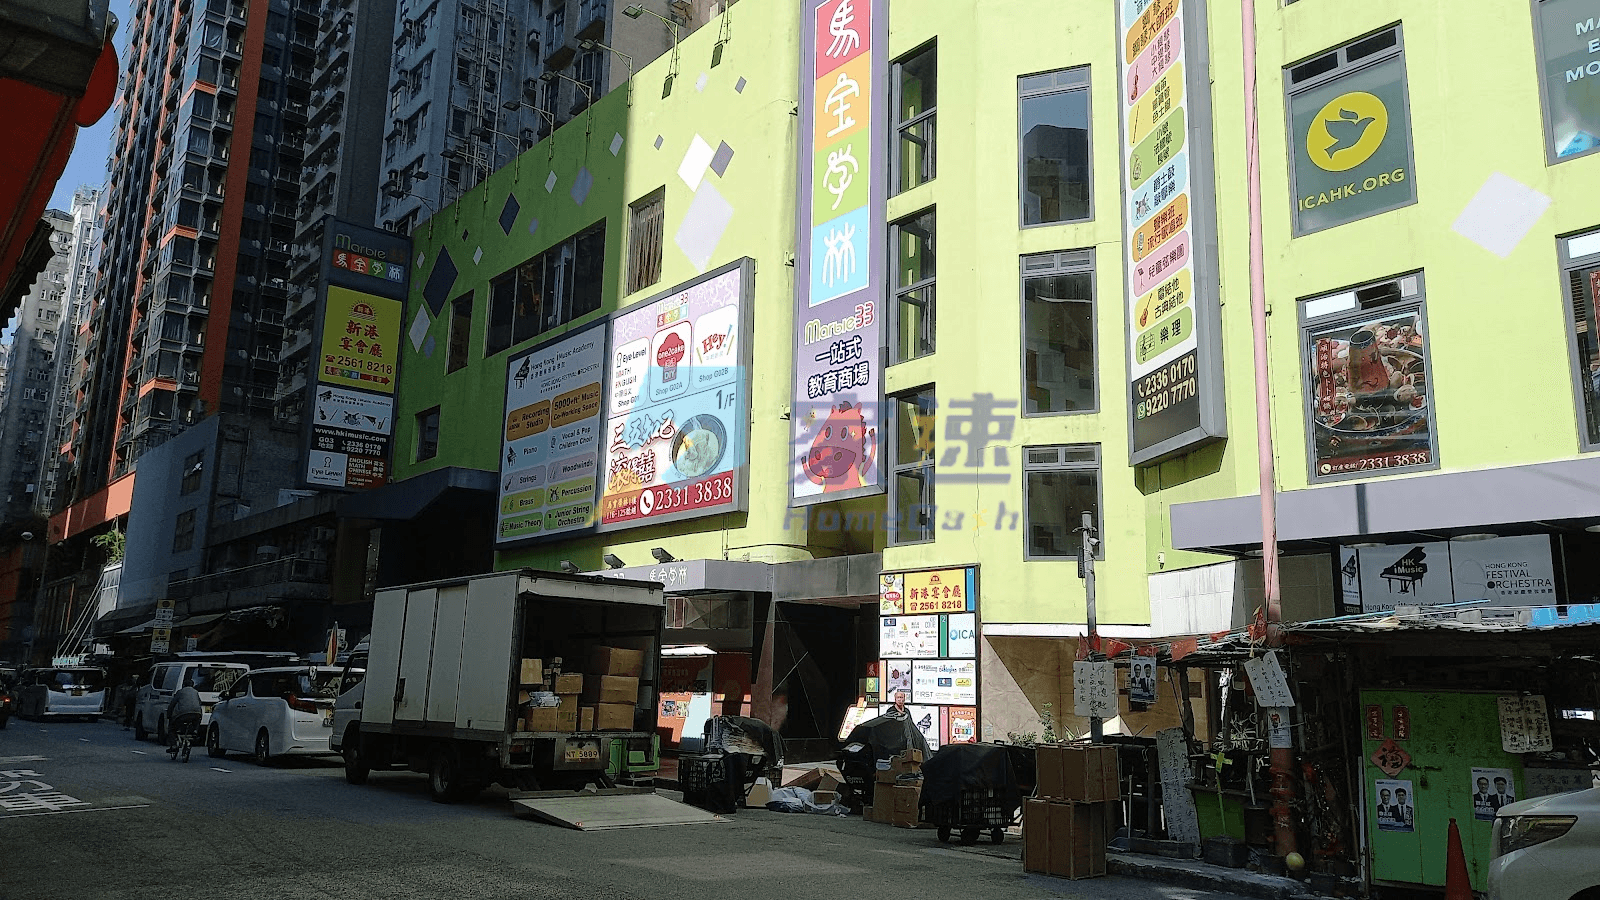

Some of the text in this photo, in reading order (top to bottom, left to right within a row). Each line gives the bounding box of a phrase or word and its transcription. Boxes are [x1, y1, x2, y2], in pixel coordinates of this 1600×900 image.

[1299, 168, 1405, 211] ICAHK.ORG
[1147, 213, 1183, 251] 流行歌唱班
[1157, 277, 1180, 301] 電結他
[1154, 290, 1184, 319] 古典結他
[345, 319, 379, 340] 新港
[804, 301, 875, 346] Marble33
[338, 336, 383, 358] 宴會廳
[658, 344, 685, 360] one2cake
[815, 334, 862, 366] 一站式
[622, 347, 647, 364] Eye Level
[337, 355, 392, 375] 2561 8218
[664, 369, 676, 380] DIY
[698, 372, 713, 382] Shop
[807, 360, 870, 399] 教育商場
[1145, 354, 1195, 396] 2336 0170
[581, 390, 599, 401] Music
[655, 386, 668, 396] Shop
[1145, 377, 1196, 417] 9220 7770
[582, 400, 598, 411] Space
[617, 397, 629, 408] Shop
[715, 389, 736, 411] 1/F
[521, 406, 550, 422] Recording
[526, 418, 544, 430] Studio
[314, 427, 387, 443] www.hkimusic.com
[318, 436, 334, 444] G03
[561, 429, 575, 440] Vocal
[581, 425, 591, 435] Pop
[558, 435, 594, 451] Children Choir
[364, 448, 381, 456] 7770
[523, 446, 538, 456] Piano
[562, 458, 594, 474] Woodwinds
[1359, 456, 1390, 470] 2331
[1393, 452, 1427, 466] 3838
[311, 467, 343, 477] Eye Level
[519, 474, 537, 485] Strings
[561, 484, 592, 497] Percussion
[655, 476, 733, 511] 2331 3838
[519, 498, 534, 507] Brass
[554, 504, 590, 519] Junior String
[509, 518, 543, 530] Music Theory
[557, 516, 585, 527] Orchestra
[1394, 564, 1424, 575] iMusic
[1401, 558, 1415, 566] HK
[1486, 569, 1532, 579] FESTIVAL
[909, 585, 962, 600] 新港宴會廳
[919, 600, 962, 611] 2561 8218
[1365, 603, 1380, 611] Hong
